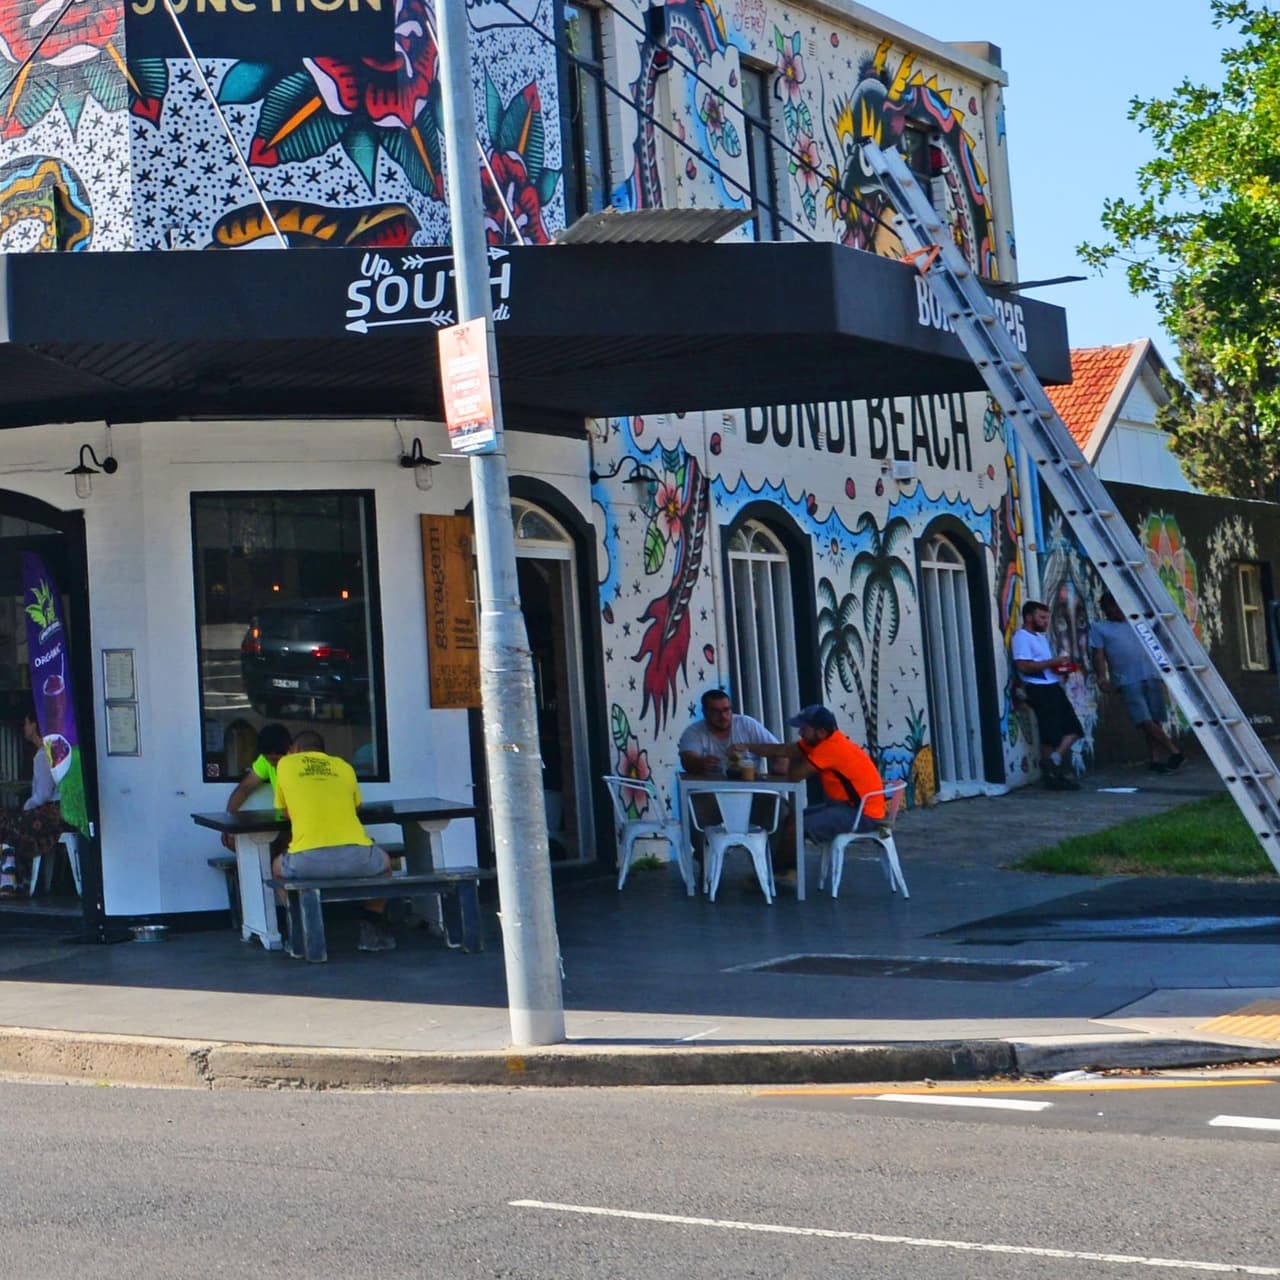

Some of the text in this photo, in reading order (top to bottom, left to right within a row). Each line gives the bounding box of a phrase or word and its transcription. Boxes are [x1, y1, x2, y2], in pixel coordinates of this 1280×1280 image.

[346, 263, 511, 318] SOUH
[361, 252, 394, 281] Up
[866, 393, 973, 472] BEACH
